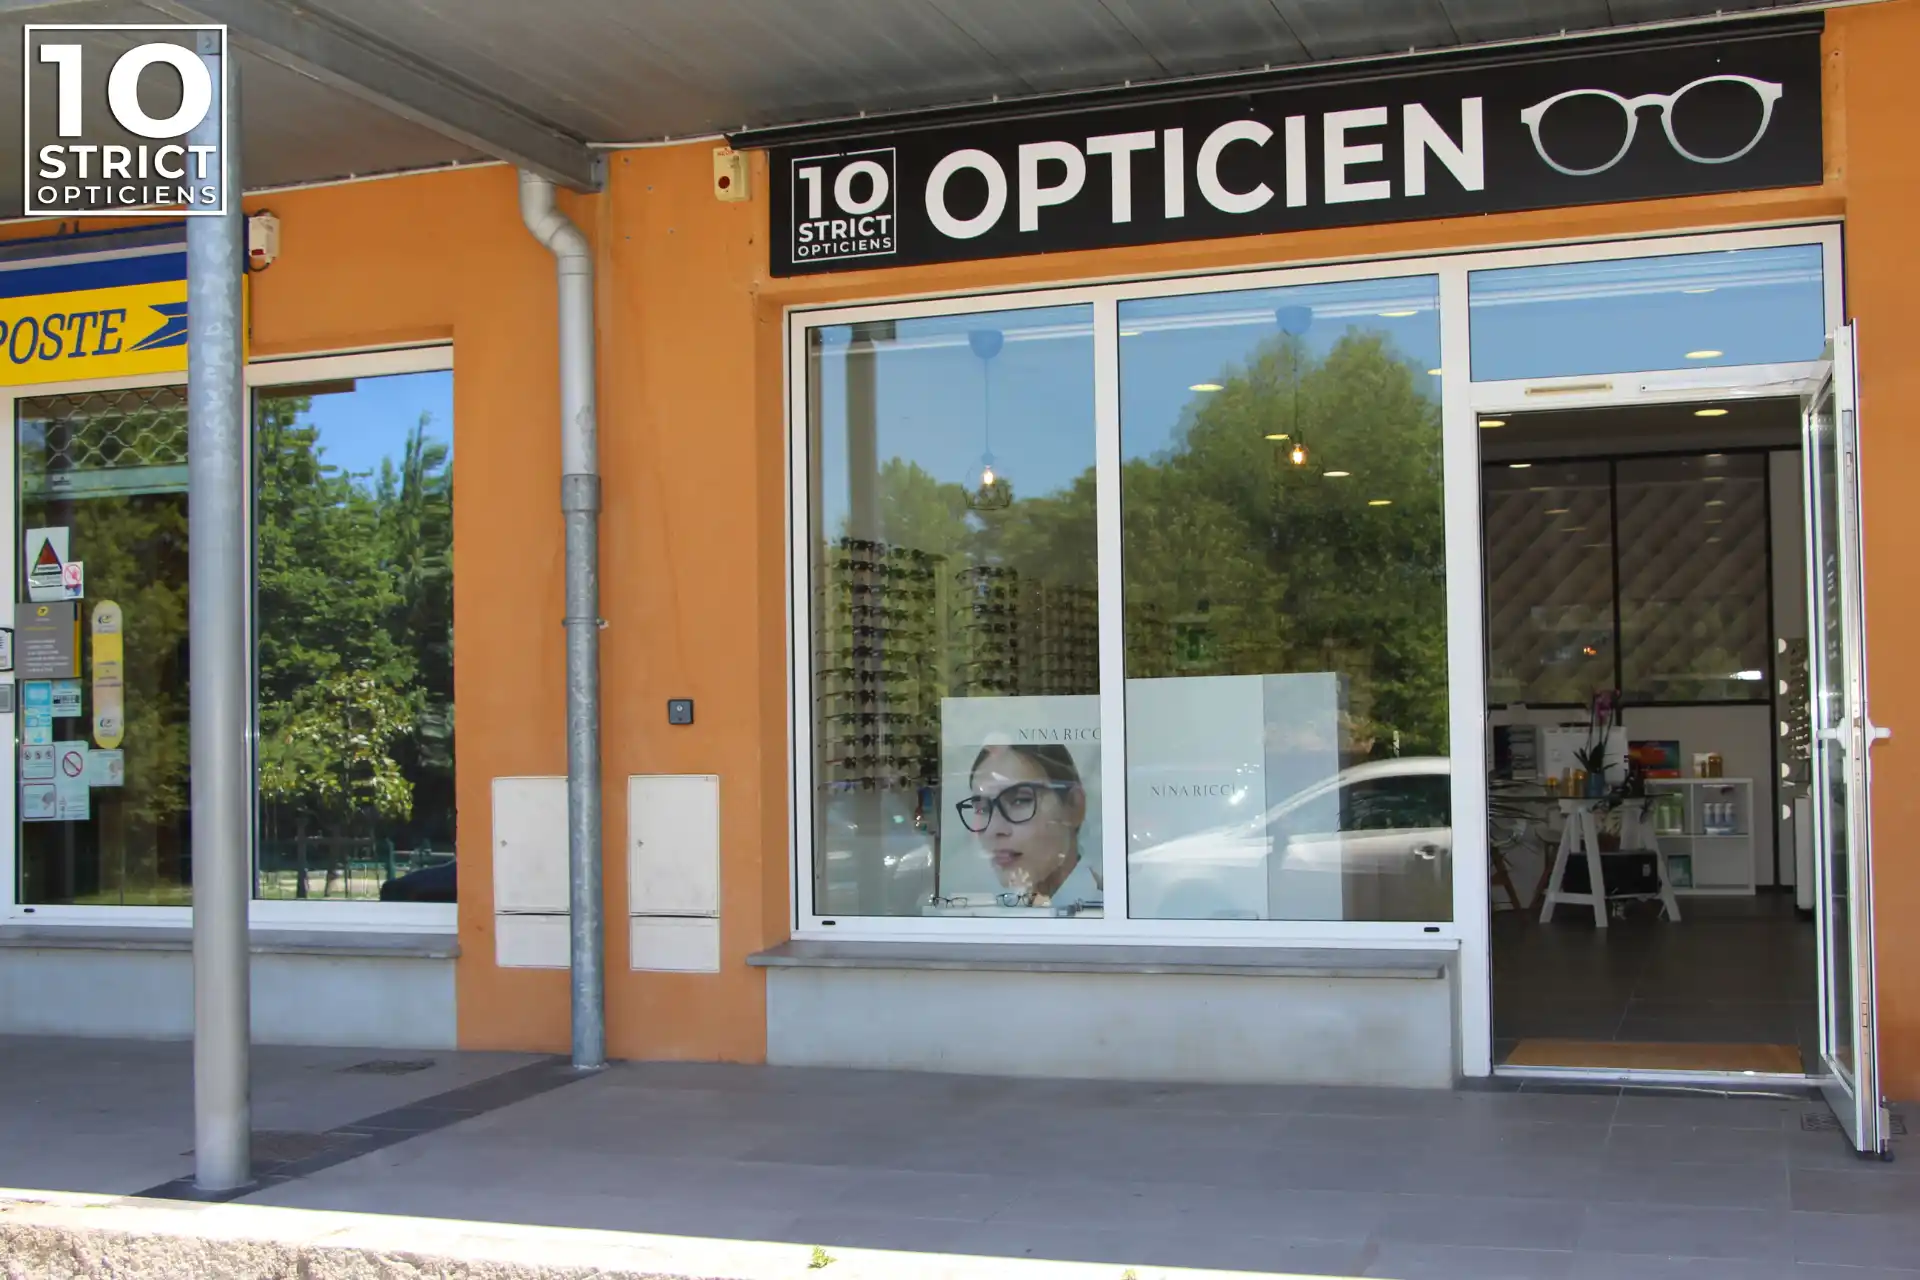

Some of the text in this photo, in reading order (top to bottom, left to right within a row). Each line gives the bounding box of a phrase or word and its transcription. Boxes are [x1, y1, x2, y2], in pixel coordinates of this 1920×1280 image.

[925, 96, 1485, 239] OPTICIEN
[799, 160, 889, 219] 10
[798, 214, 892, 243] STRICT
[798, 237, 892, 257] OPTICIENS
[1018, 726, 1101, 741] NINA RICC
[1151, 783, 1189, 798] NINA
